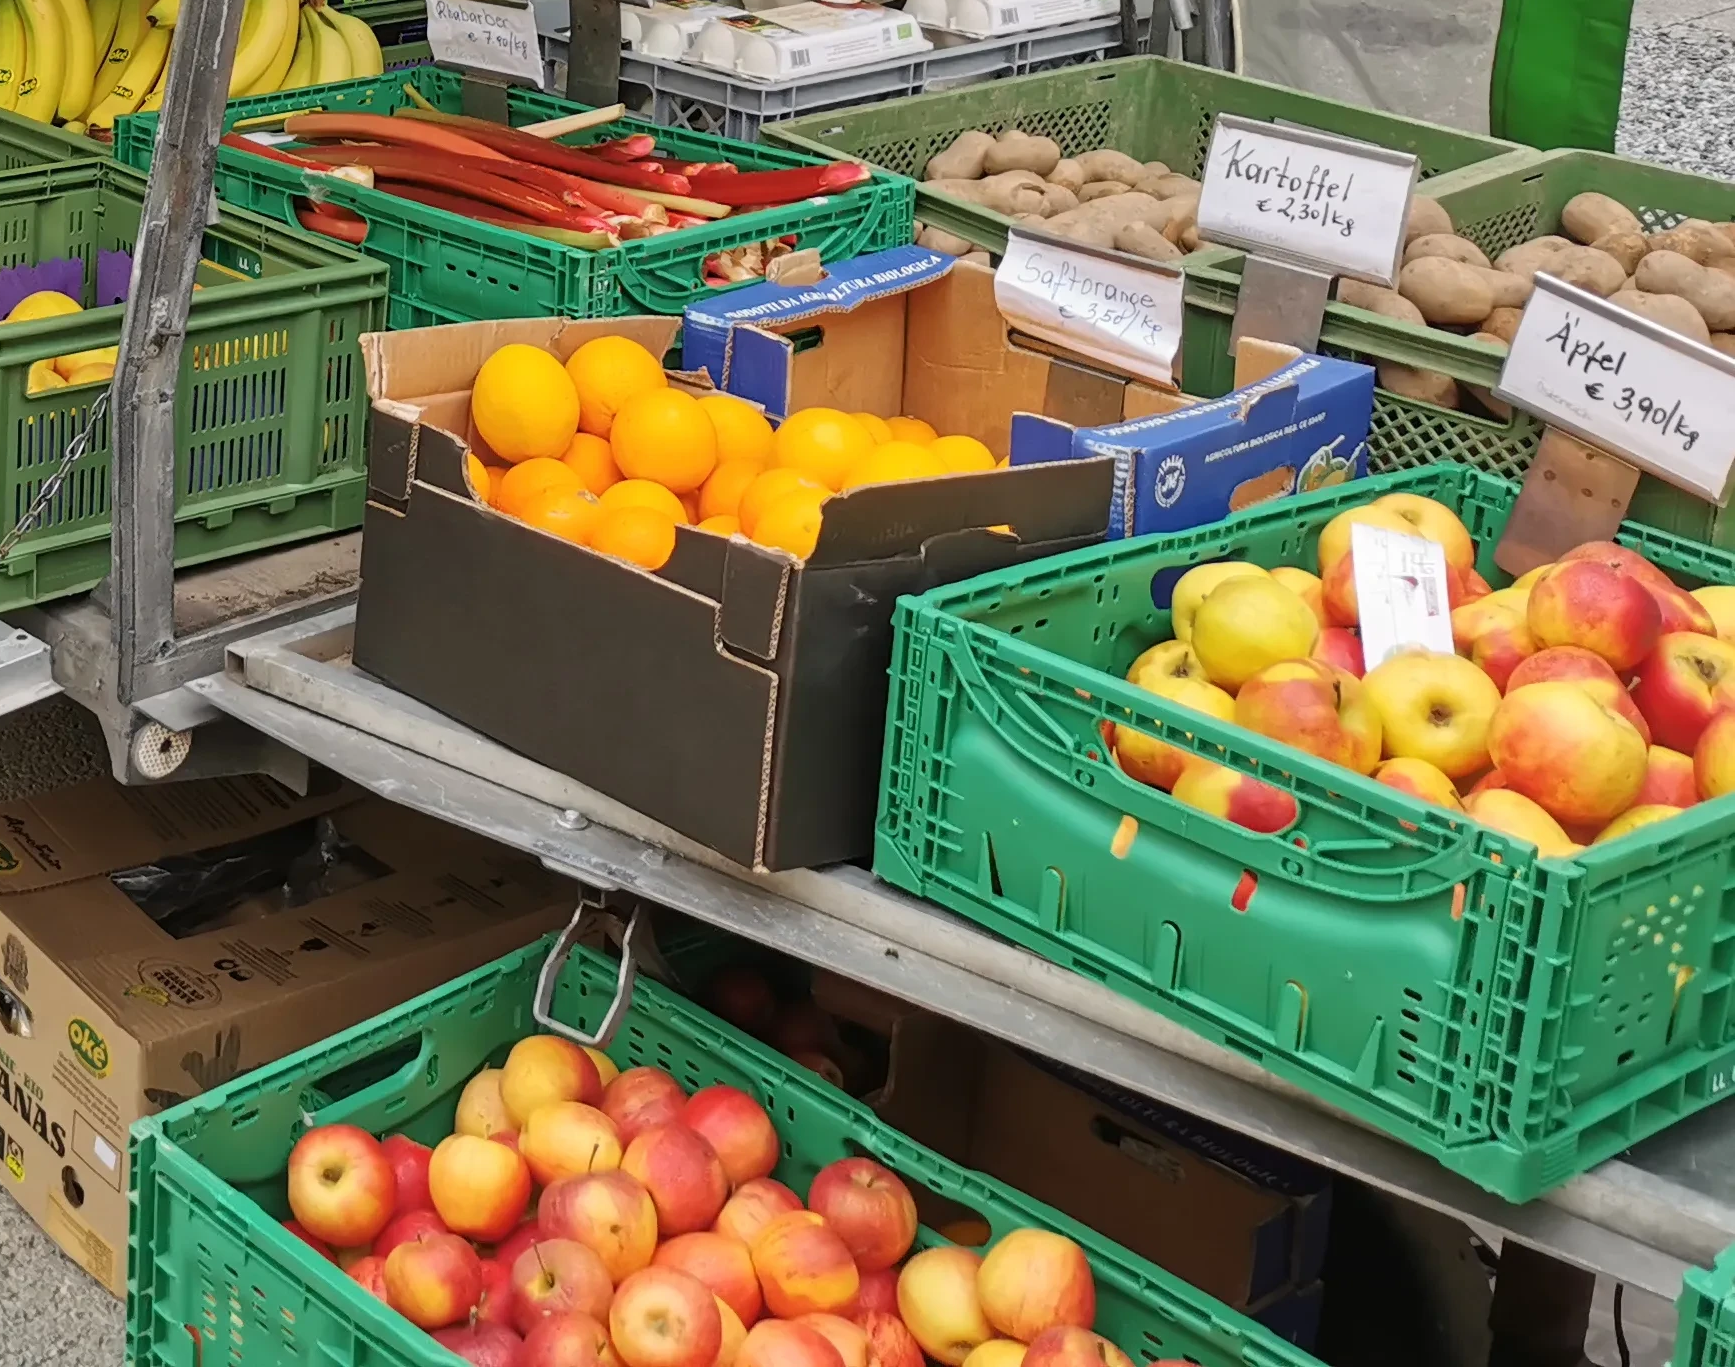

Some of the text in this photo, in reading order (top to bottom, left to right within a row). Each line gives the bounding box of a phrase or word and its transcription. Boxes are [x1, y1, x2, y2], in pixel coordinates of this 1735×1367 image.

[435, 0, 509, 29] Rhabarber
[1220, 138, 1355, 202] Kartoffel
[1256, 197, 1273, 213] €
[874, 254, 942, 291] BIOLOGICA
[1017, 252, 1157, 308] Saftorange
[1058, 303, 1074, 321] €
[1545, 311, 1626, 377] Äpfel
[1583, 380, 1606, 403] €
[1249, 428, 1283, 449] BIOLOGICA
[0, 814, 62, 870] AgroFair
[69, 1022, 109, 1069] oké
[23, 1072, 44, 1103] BIO
